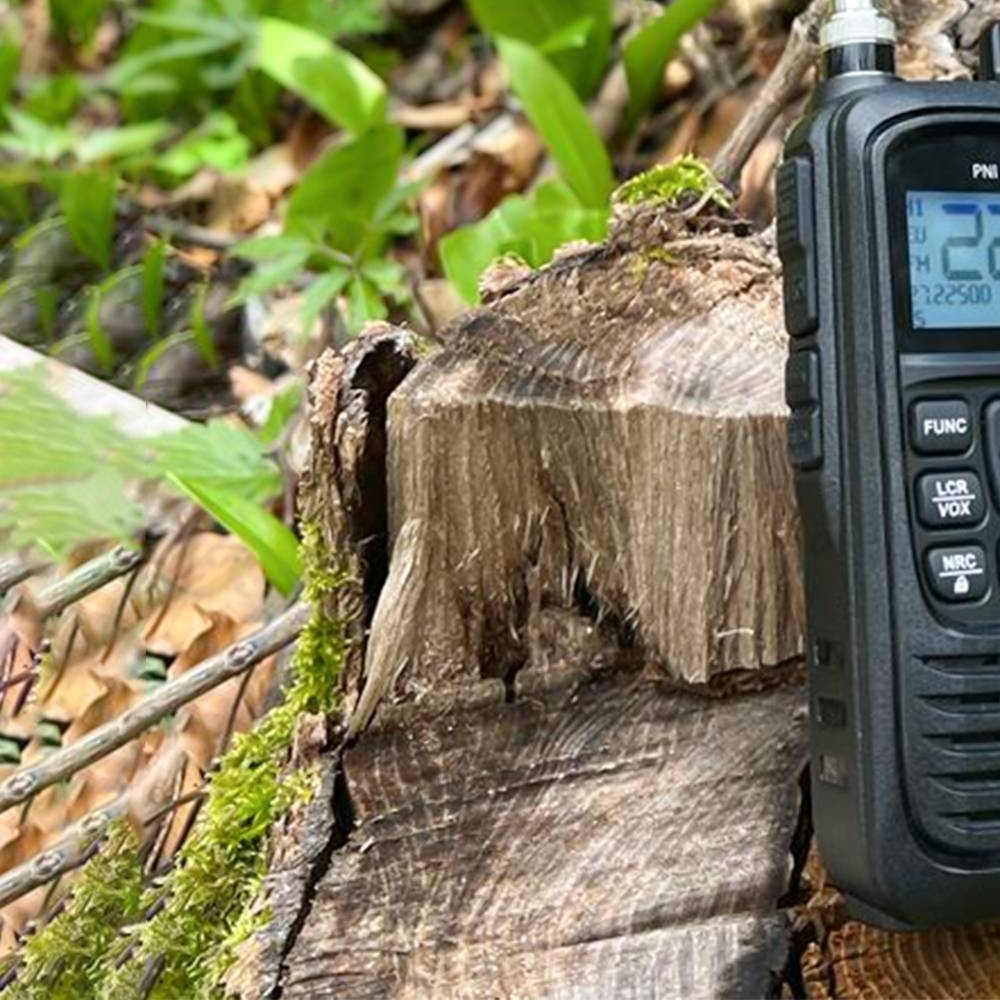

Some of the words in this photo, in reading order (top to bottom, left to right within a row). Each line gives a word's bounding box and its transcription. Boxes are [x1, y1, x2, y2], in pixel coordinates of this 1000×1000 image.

[971, 163, 998, 179] PNI
[923, 417, 967, 436] FUNC
[936, 479, 969, 497] LCR
[938, 501, 971, 518] VOX
[941, 554, 977, 570] NRC
